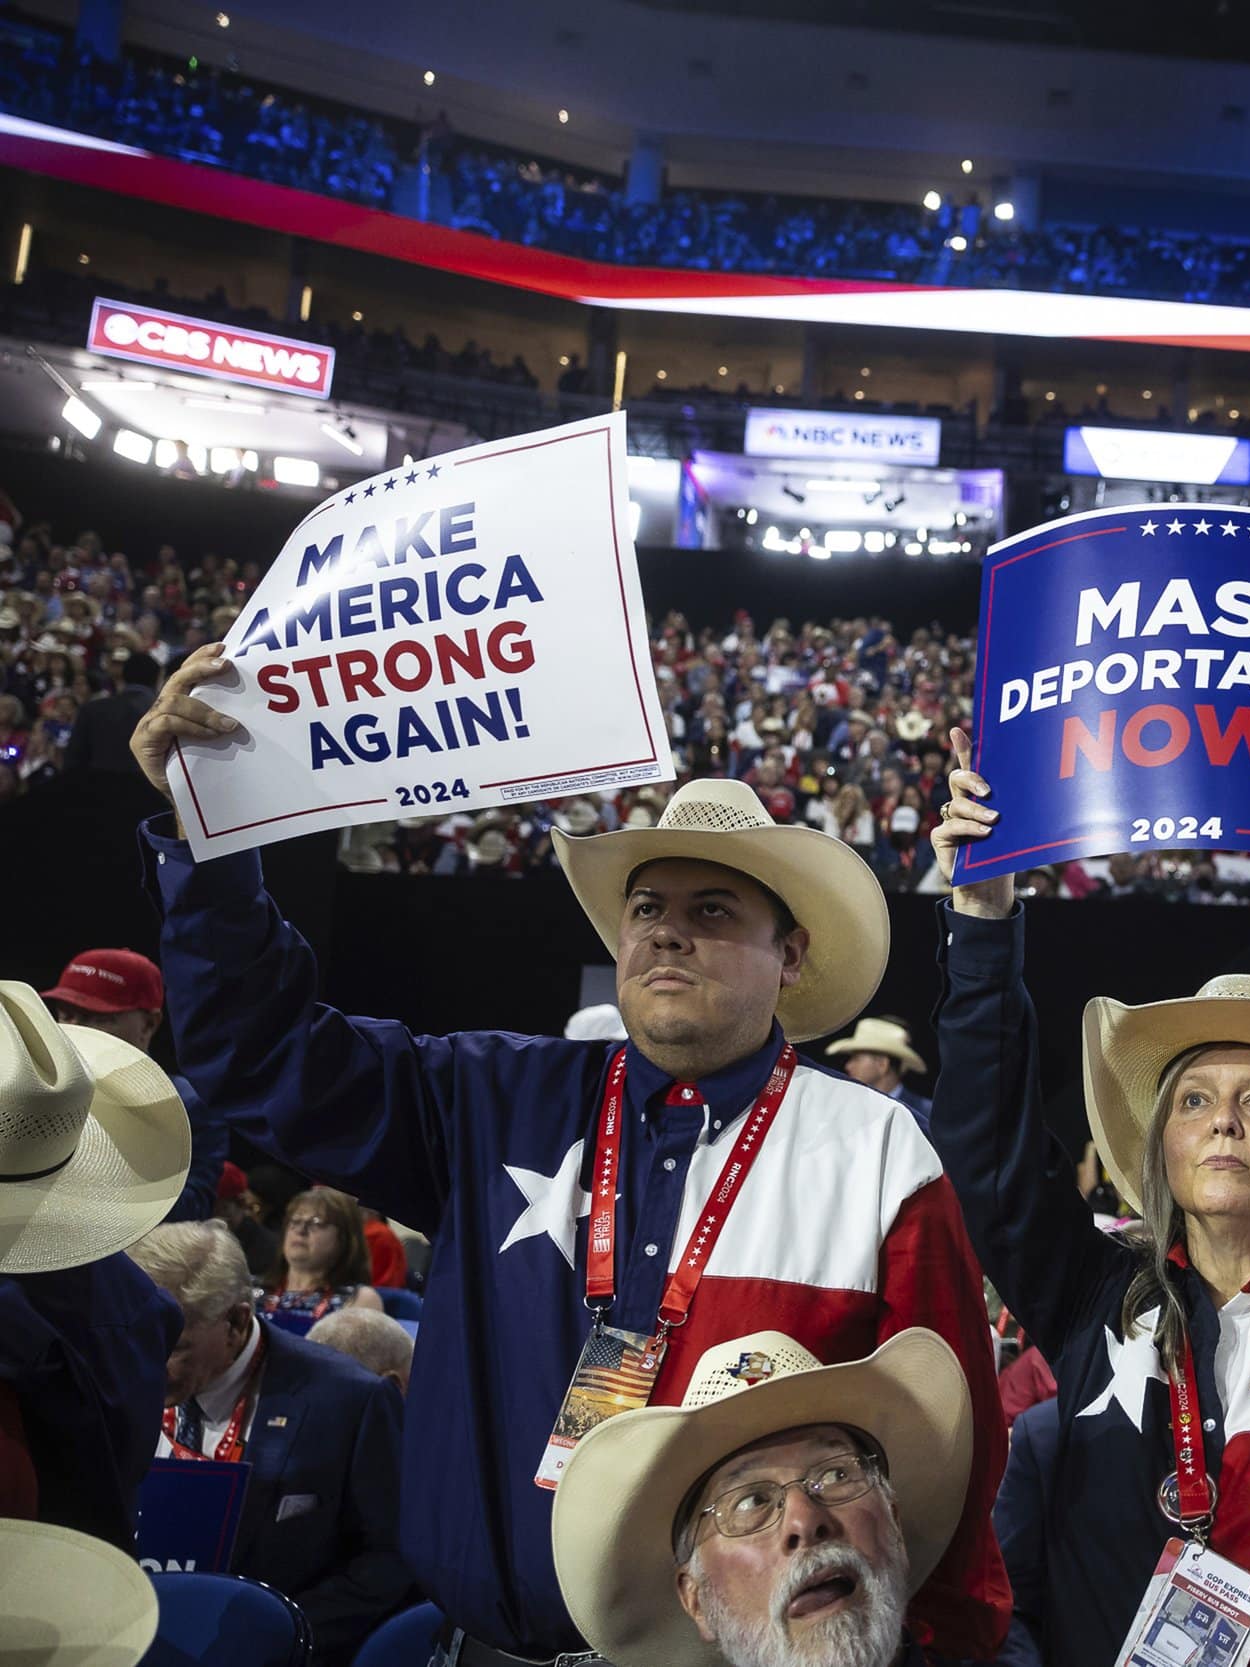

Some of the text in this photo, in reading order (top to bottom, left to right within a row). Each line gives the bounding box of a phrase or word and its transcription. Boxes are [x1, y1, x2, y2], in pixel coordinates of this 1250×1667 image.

[136, 321, 321, 383] CBS NEWS
[794, 425, 923, 449] NBC NEWS
[296, 501, 477, 588] MAKE
[234, 554, 545, 657] AMERICA
[257, 620, 536, 714] STRONG
[309, 687, 531, 770] AGAIN!
[395, 778, 469, 807] 2024
[1130, 816, 1223, 842] 2024
[606, 1096, 617, 1136] RNC2024
[717, 1162, 742, 1204] RNC2024
[594, 1216, 605, 1239] DATA
[601, 1210, 610, 1239] TRUST
[1203, 1579, 1239, 1604] BUS PASS
[1206, 1572, 1224, 1587] GOP
[1207, 1594, 1220, 1606] BUS
[1219, 1601, 1240, 1618] DEPOT
